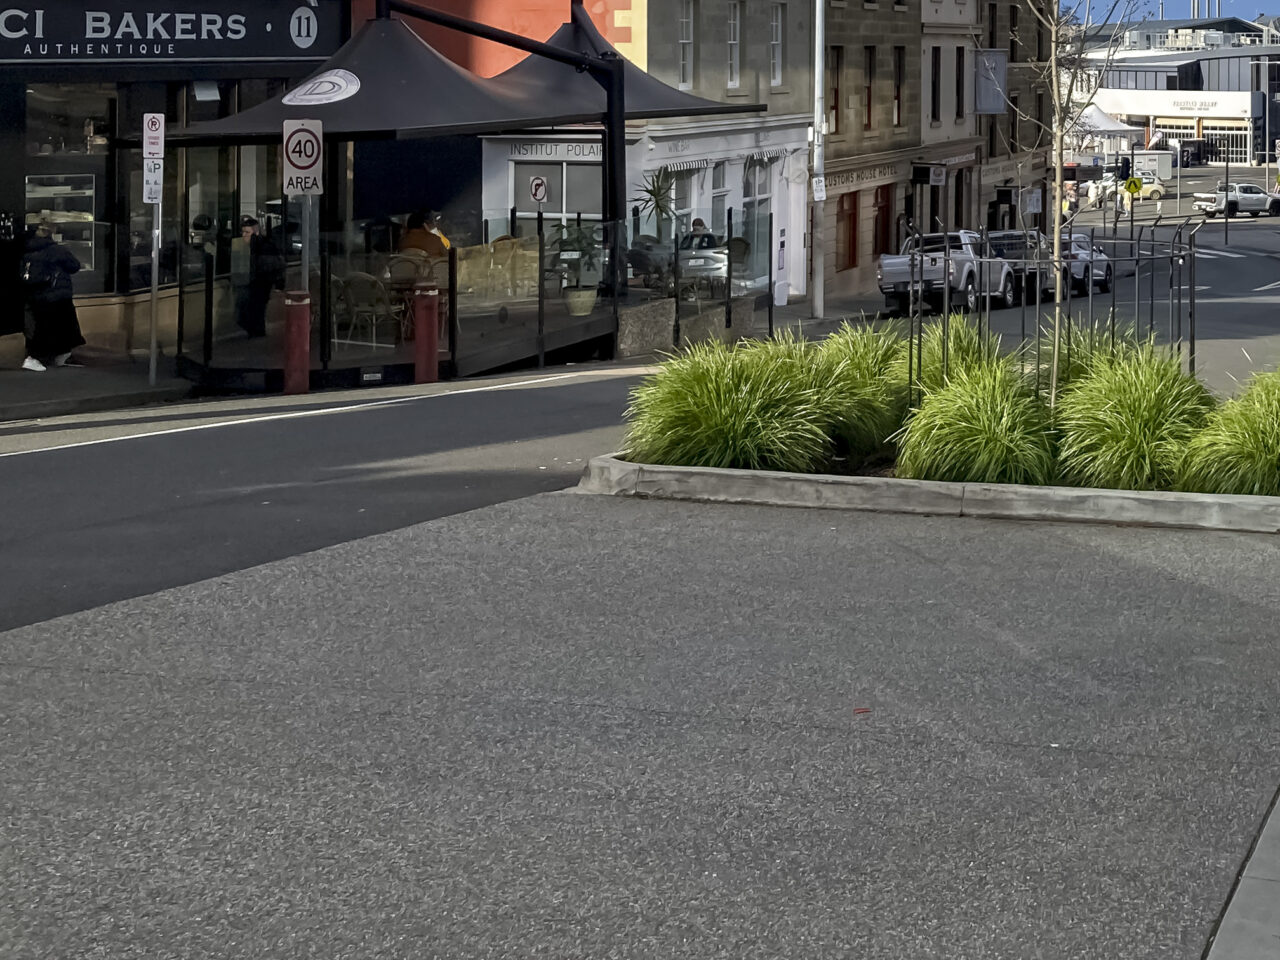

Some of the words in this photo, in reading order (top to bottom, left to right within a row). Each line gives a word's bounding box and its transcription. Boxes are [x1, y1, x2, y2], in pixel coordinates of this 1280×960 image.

[0, 8, 45, 39] CI
[85, 10, 247, 40] BAKERS
[294, 14, 312, 38] 11
[23, 43, 176, 55] AUTHENTIQUE
[291, 139, 315, 159] 40
[510, 144, 560, 156] INSTITUT
[286, 176, 319, 191] AREA
